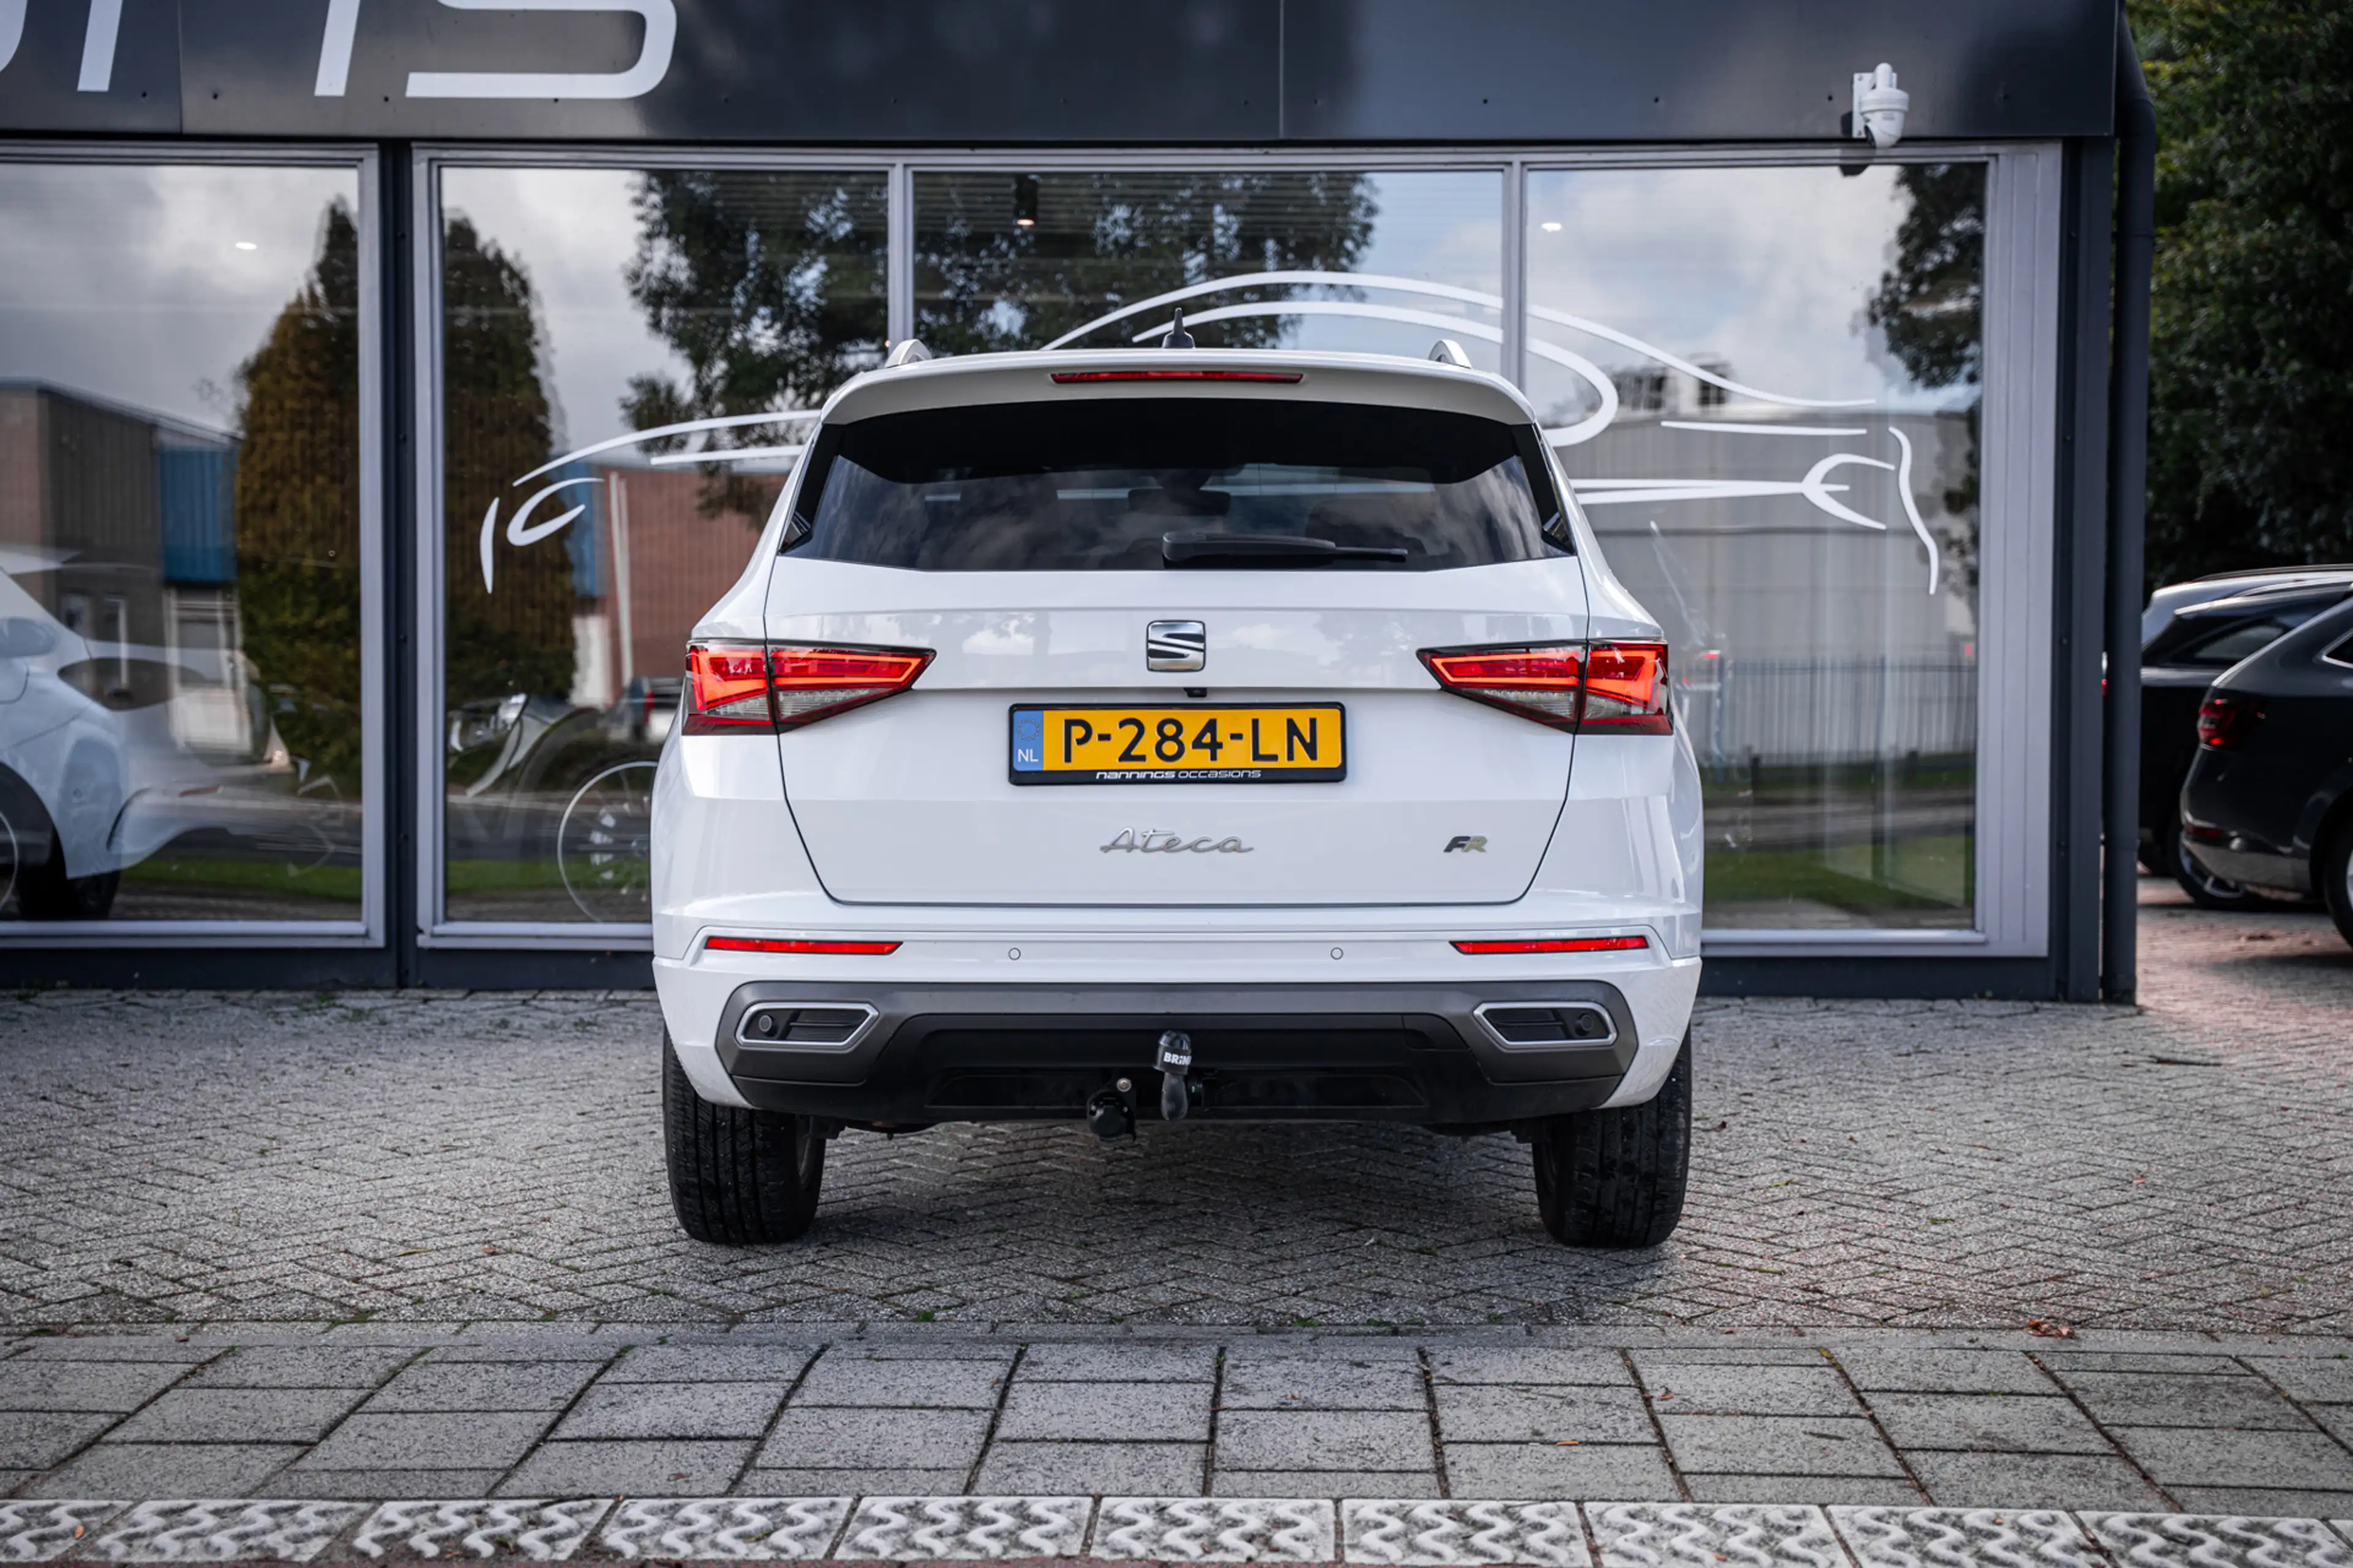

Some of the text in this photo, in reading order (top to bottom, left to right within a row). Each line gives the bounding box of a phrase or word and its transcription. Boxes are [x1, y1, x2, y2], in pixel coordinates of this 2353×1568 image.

[1063, 718, 1318, 763] P-284-LN
[1017, 748, 1039, 762] NL
[1178, 770, 1262, 779] occasions
[1099, 827, 1254, 854] Ateca
[1443, 835, 1488, 854] FR
